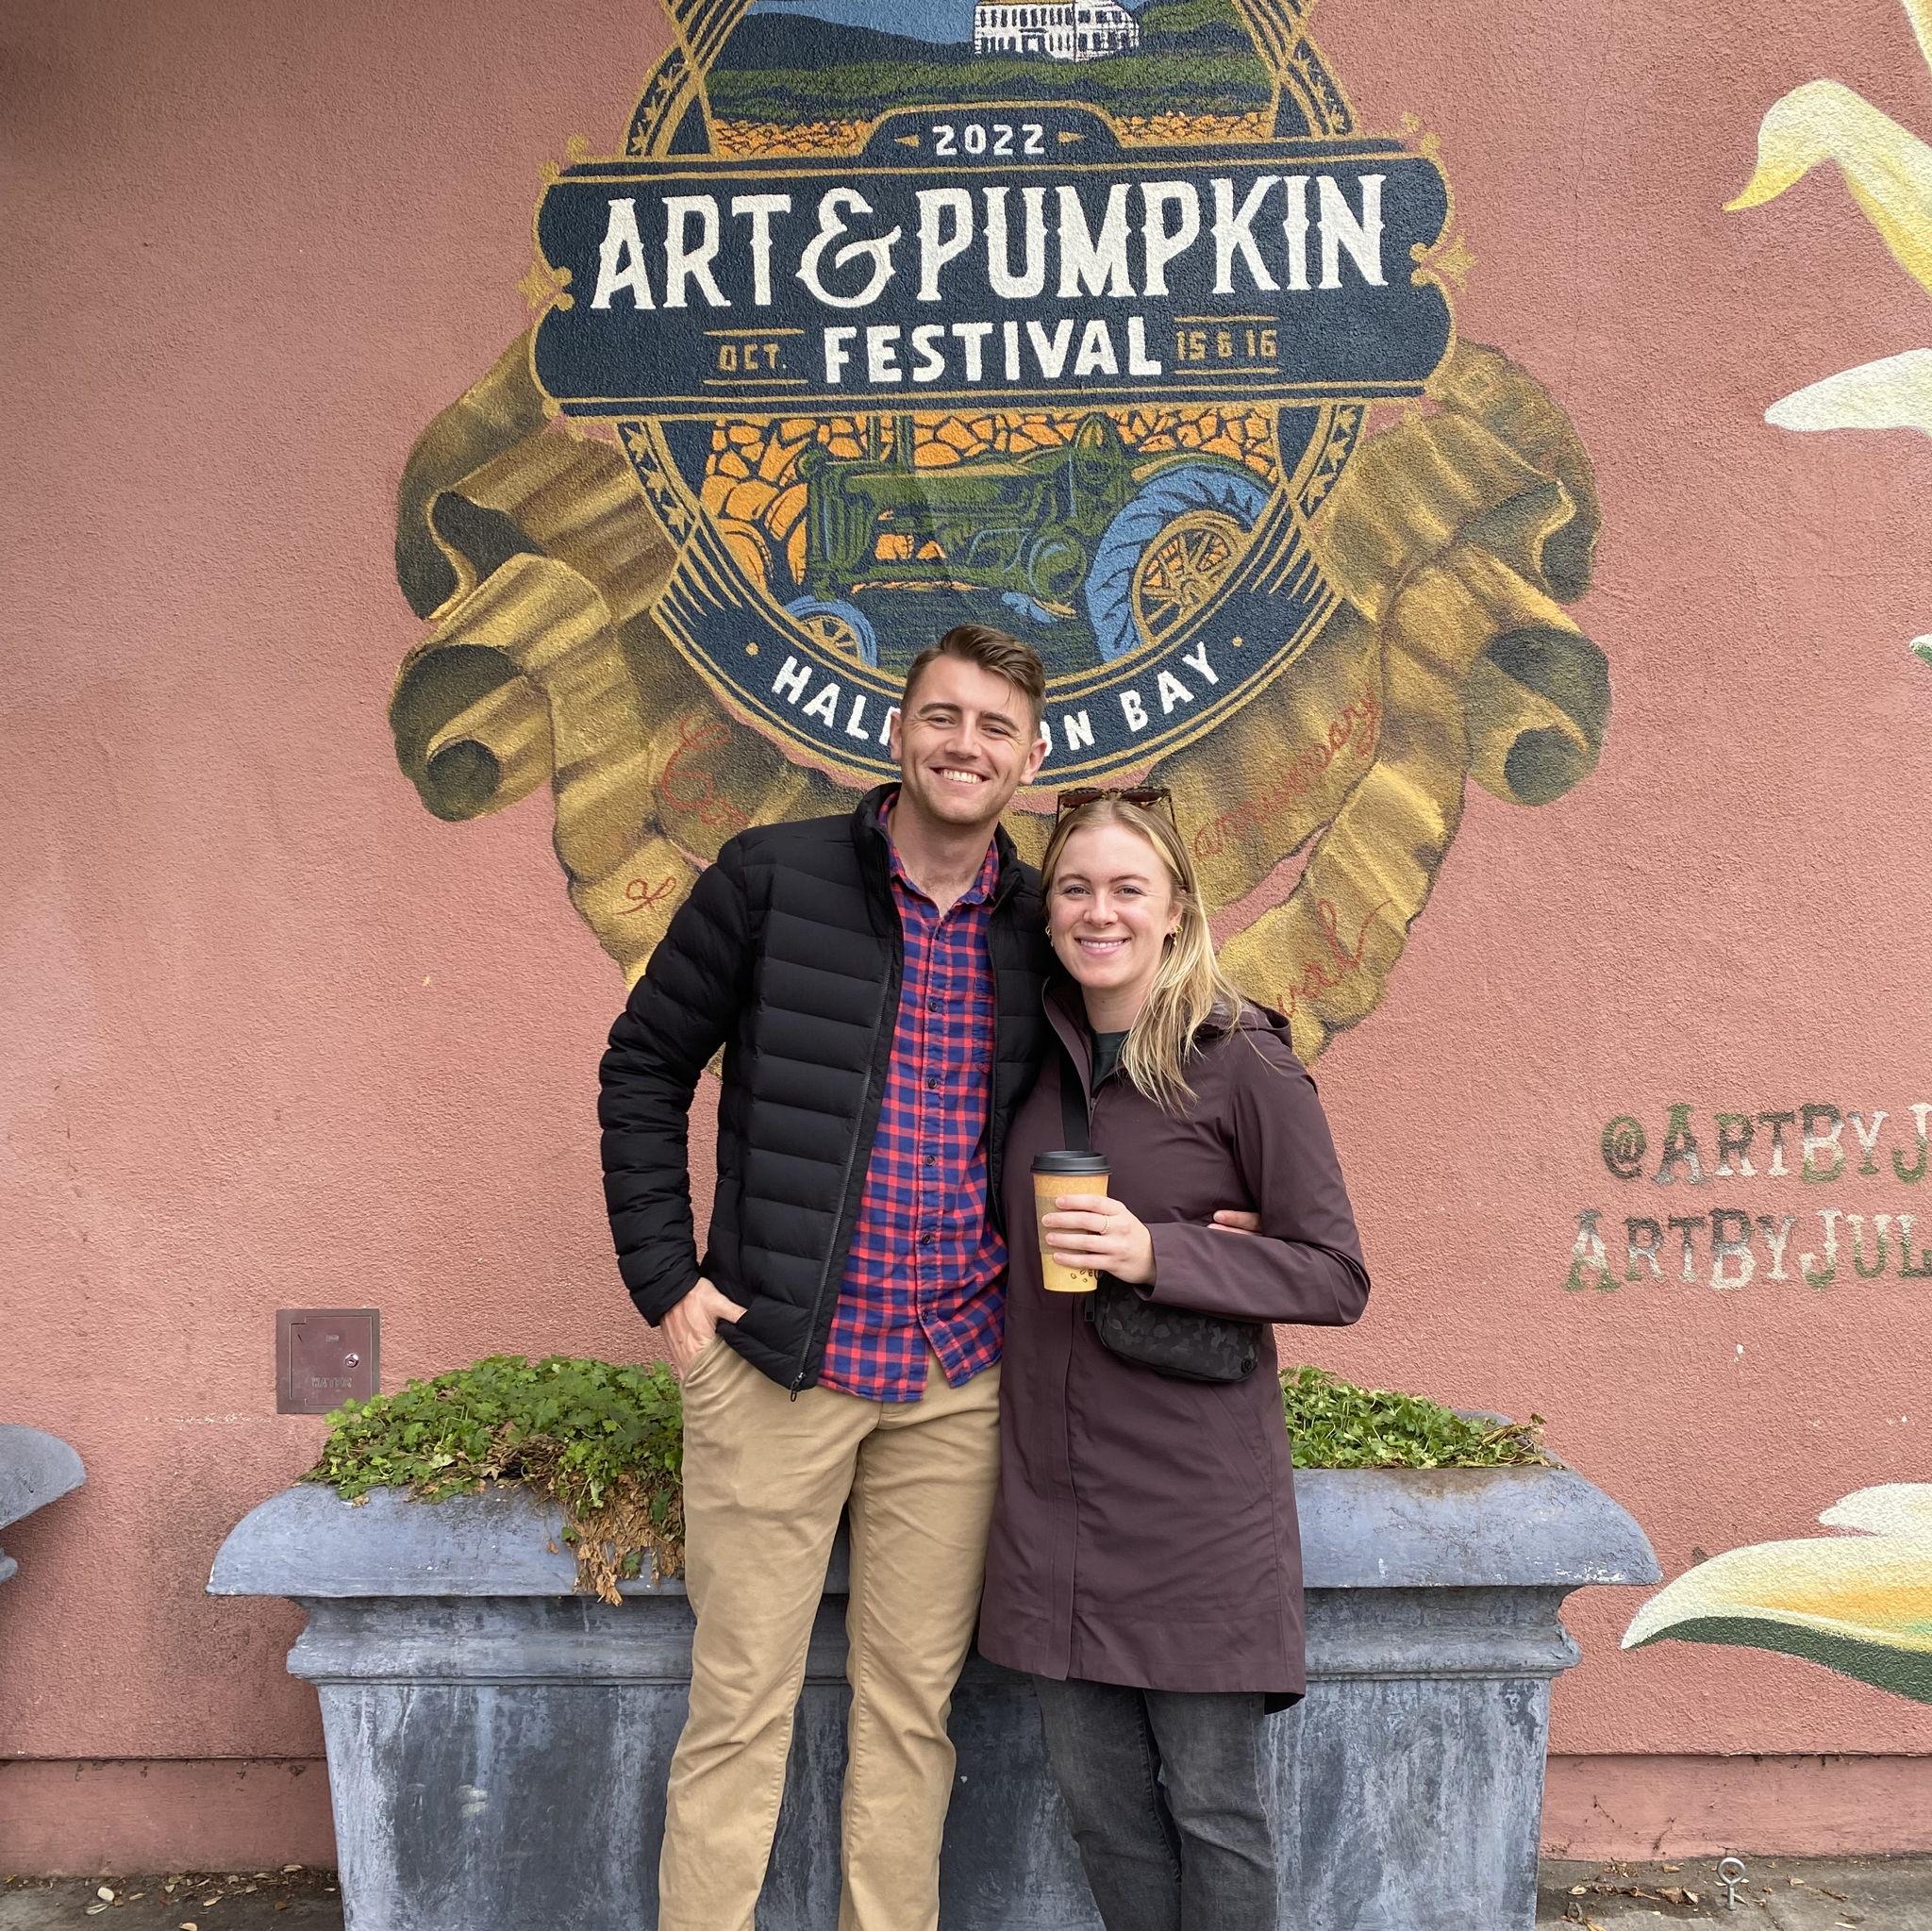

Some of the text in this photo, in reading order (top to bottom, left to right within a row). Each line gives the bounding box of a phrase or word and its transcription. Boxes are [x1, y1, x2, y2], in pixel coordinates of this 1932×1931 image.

[932, 124, 1045, 156] 2022
[590, 174, 1389, 310] ART & PUMPKIN
[718, 342, 787, 372] OCT.
[824, 316, 1162, 384] FESTIVAL
[1176, 330, 1207, 361] 15
[1246, 329, 1277, 358] 16
[1119, 641, 1219, 732] BAY
